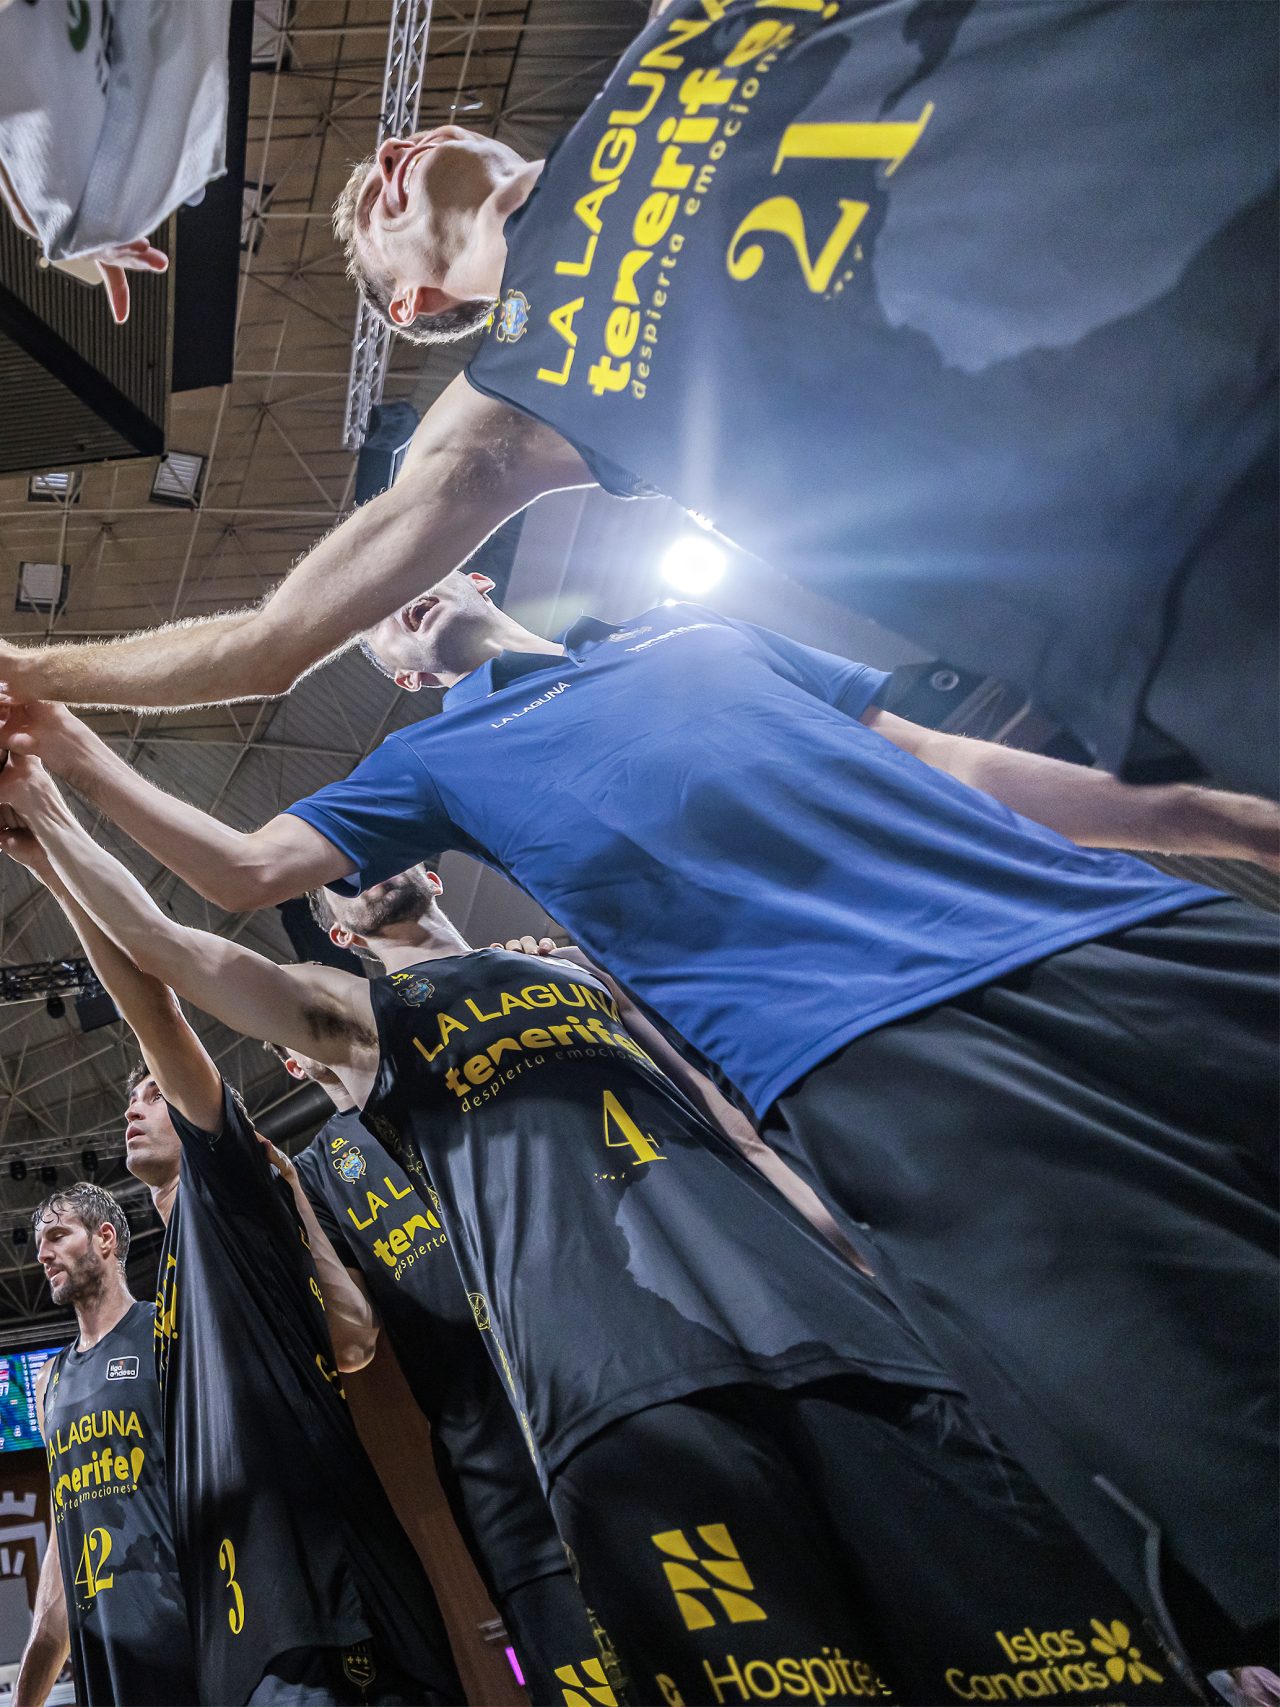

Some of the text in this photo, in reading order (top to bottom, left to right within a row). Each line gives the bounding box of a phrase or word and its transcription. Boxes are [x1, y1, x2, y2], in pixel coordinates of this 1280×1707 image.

[631, 35, 793, 399] despierta emocion
[727, 101, 935, 293] 21
[536, 296, 585, 386] LA
[491, 681, 572, 729] LA LAGUNA
[412, 1012, 470, 1063] LA
[461, 1054, 546, 1113] despierta
[602, 1089, 668, 1166] 4
[346, 1190, 389, 1231] LA
[56, 1409, 144, 1455] LAGUNA
[74, 1527, 114, 1599] 42
[219, 1537, 245, 1635] 3
[995, 1627, 1087, 1665] Islas
[703, 1647, 892, 1706] Hospite
[945, 1658, 1110, 1700] Canarias
